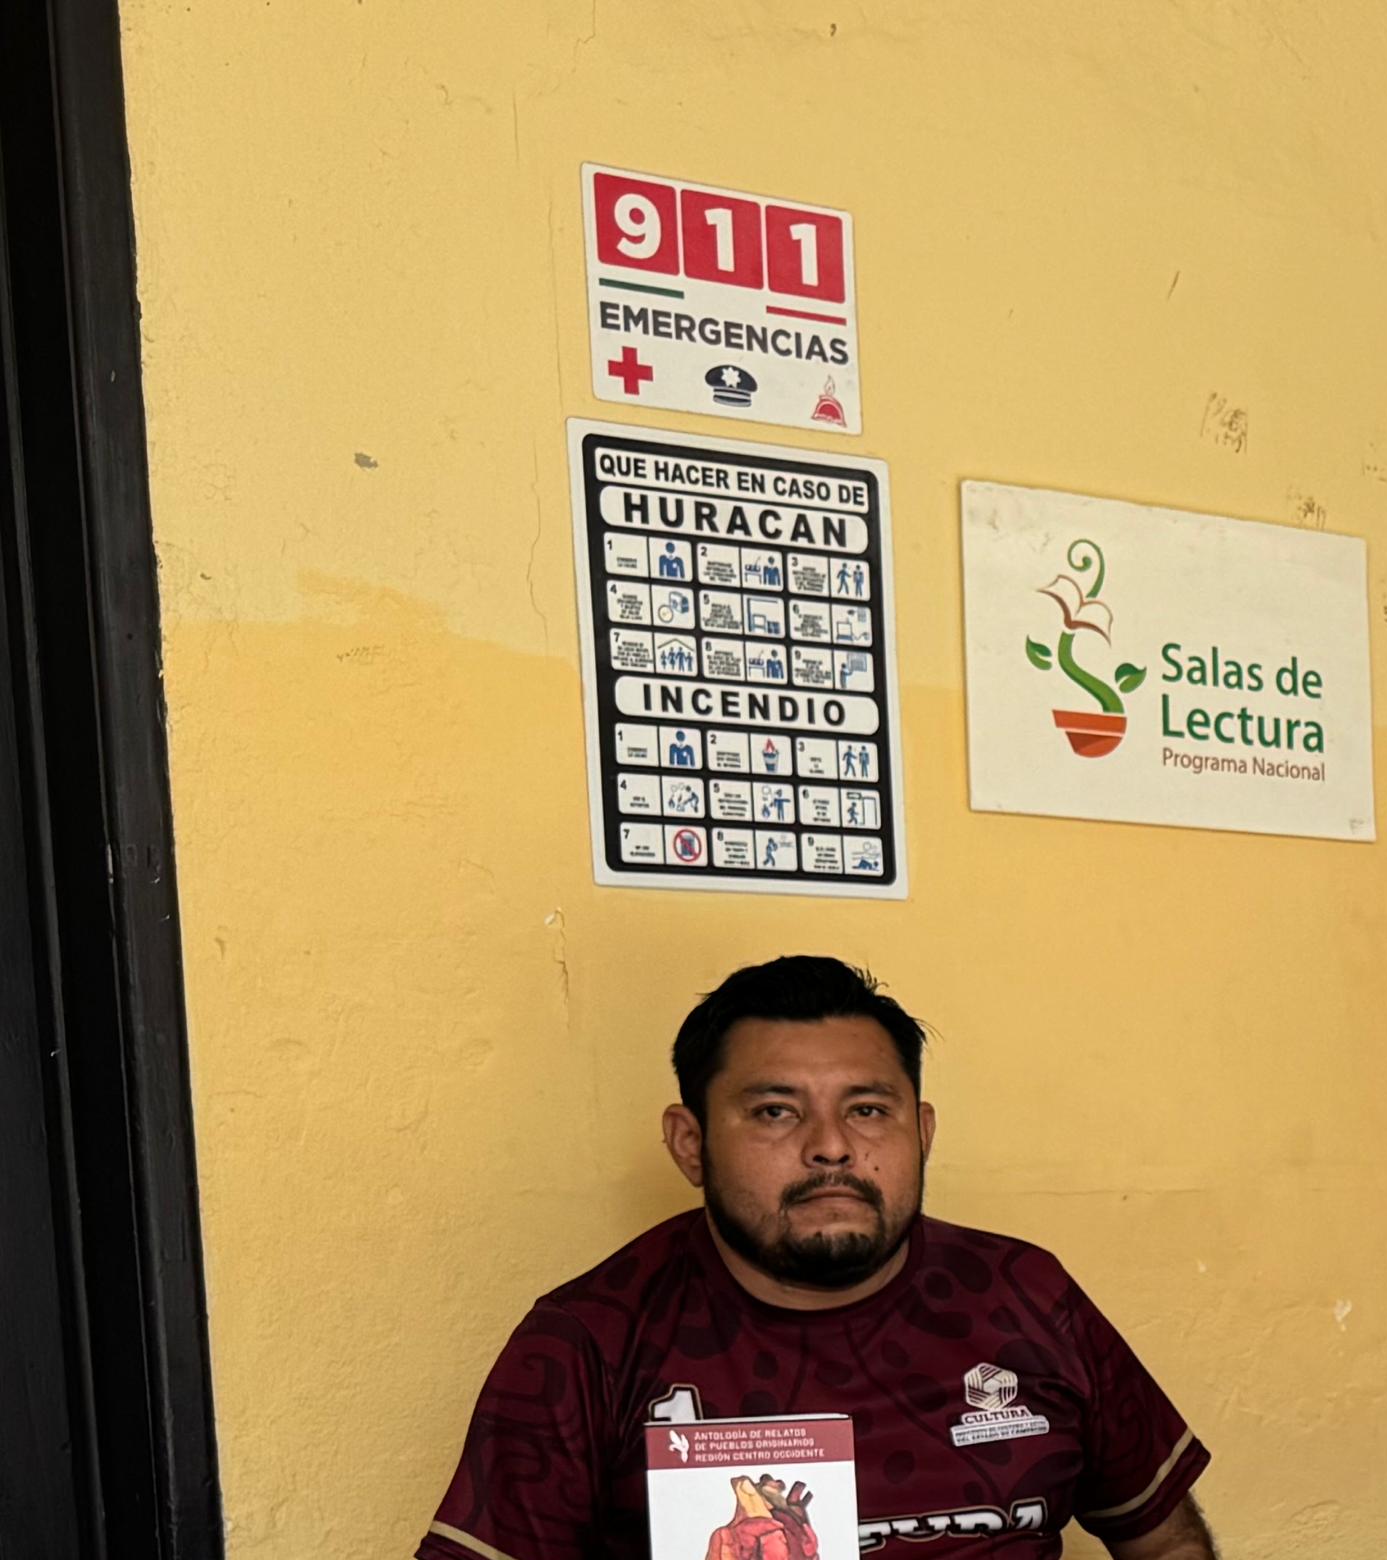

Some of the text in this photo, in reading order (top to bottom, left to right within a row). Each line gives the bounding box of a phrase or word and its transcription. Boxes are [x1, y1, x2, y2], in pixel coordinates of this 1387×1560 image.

[613, 193, 819, 287] 911
[600, 301, 849, 365] EMERGENCIAS
[600, 454, 865, 506] QUE HACER EN CASO DE
[623, 491, 847, 548] HURACAN
[1161, 642, 1322, 699] Salas de
[643, 683, 846, 726] INCENDIO
[1161, 694, 1325, 753] Lectura
[1163, 747, 1326, 782] Programa Nacional
[694, 1428, 806, 1440] ANTOLOGÍA DE RELATOS
[965, 1409, 1029, 1425] CULTURA
[695, 1438, 815, 1451] DE PUEBLOS ORIGINARIOS
[695, 1448, 825, 1462] REGIÓN CENTRO OCCIDENTE
